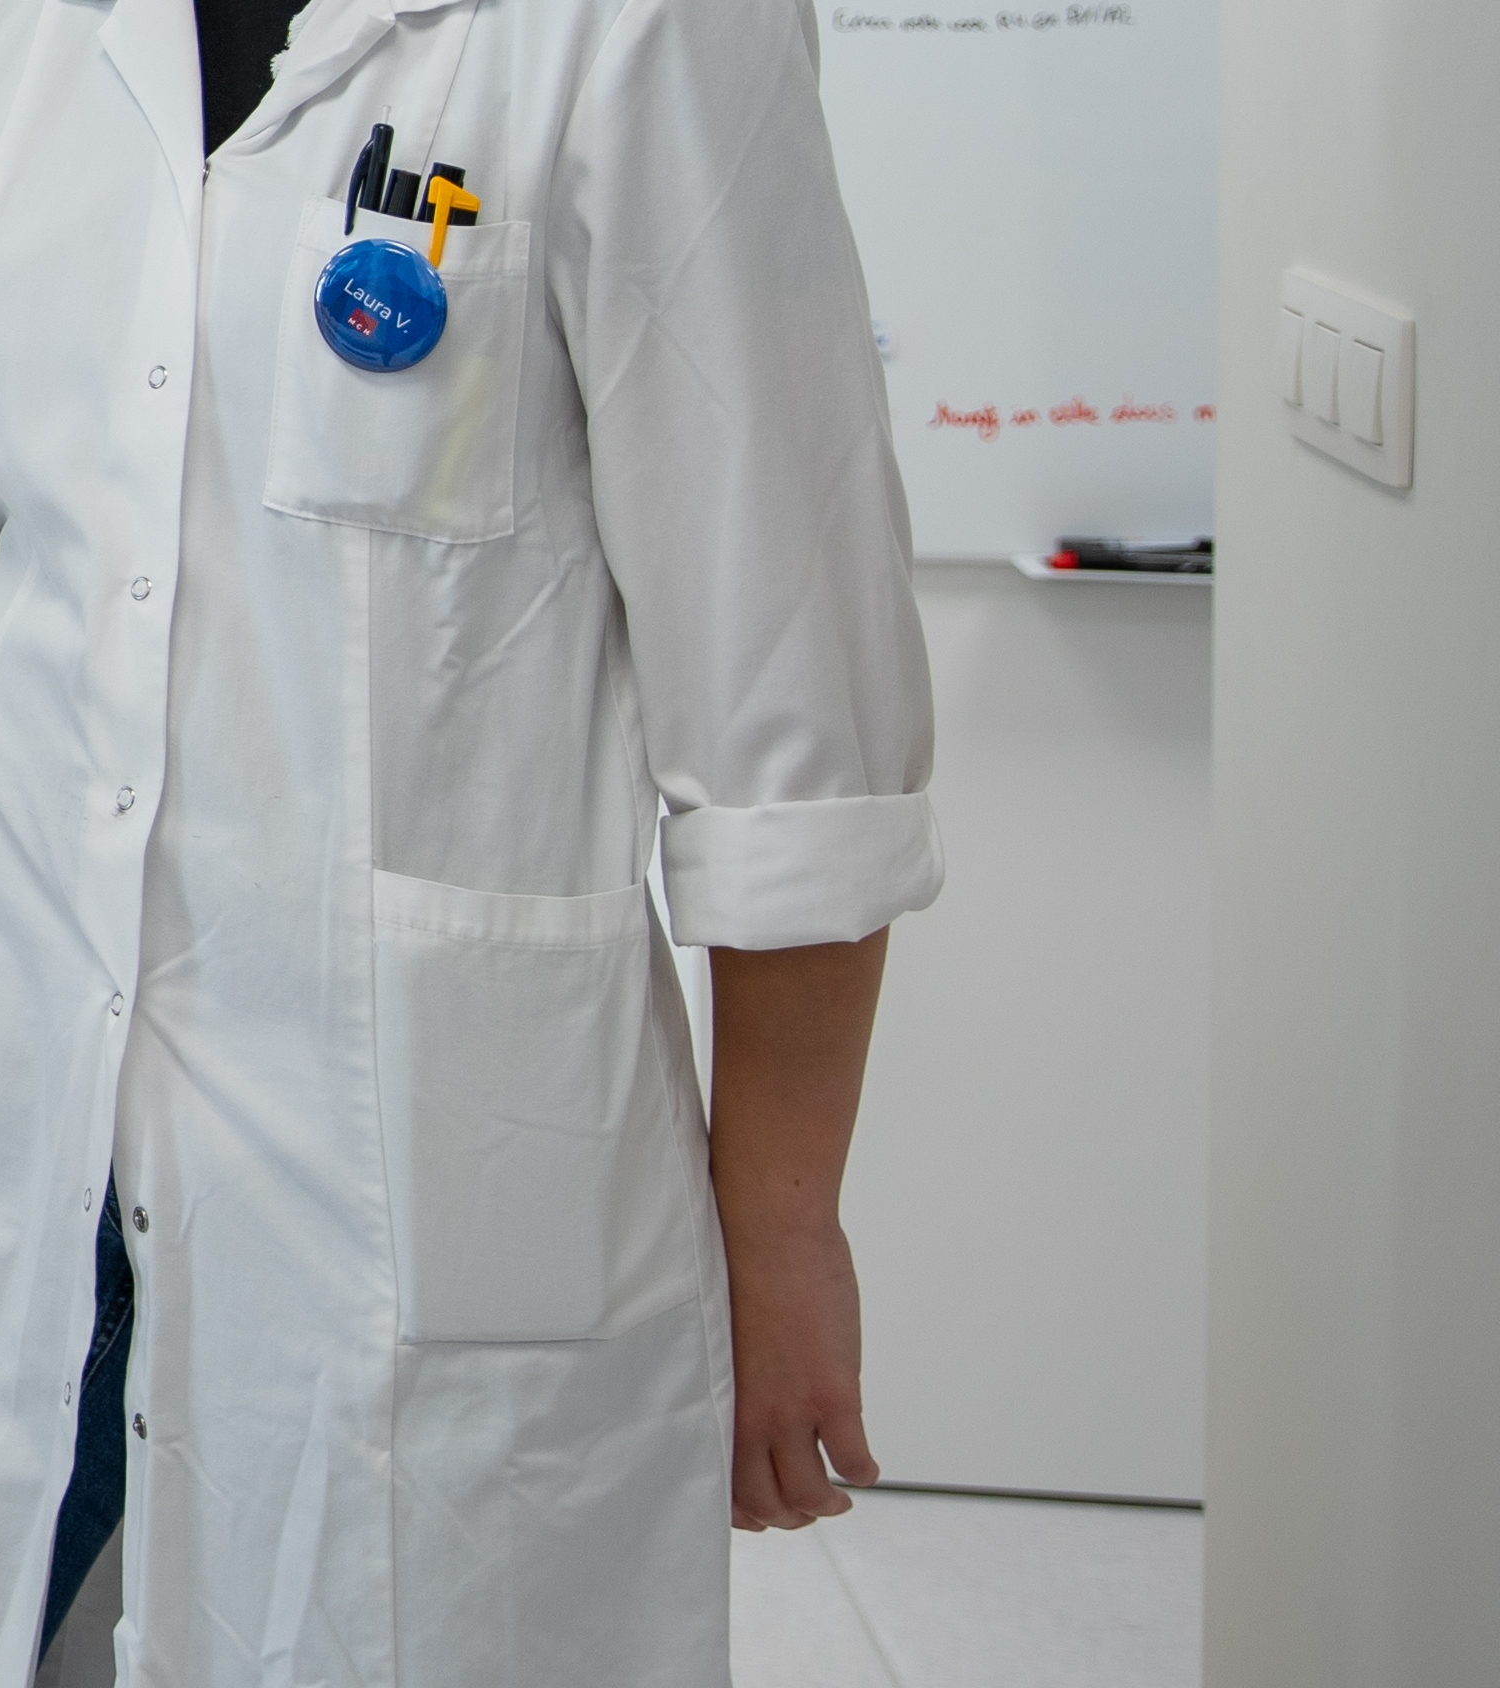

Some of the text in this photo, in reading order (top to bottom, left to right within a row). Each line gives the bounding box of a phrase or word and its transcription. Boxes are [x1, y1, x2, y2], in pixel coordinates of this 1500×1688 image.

[343, 278, 412, 334] Laura V.
[348, 317, 371, 336] MCH
